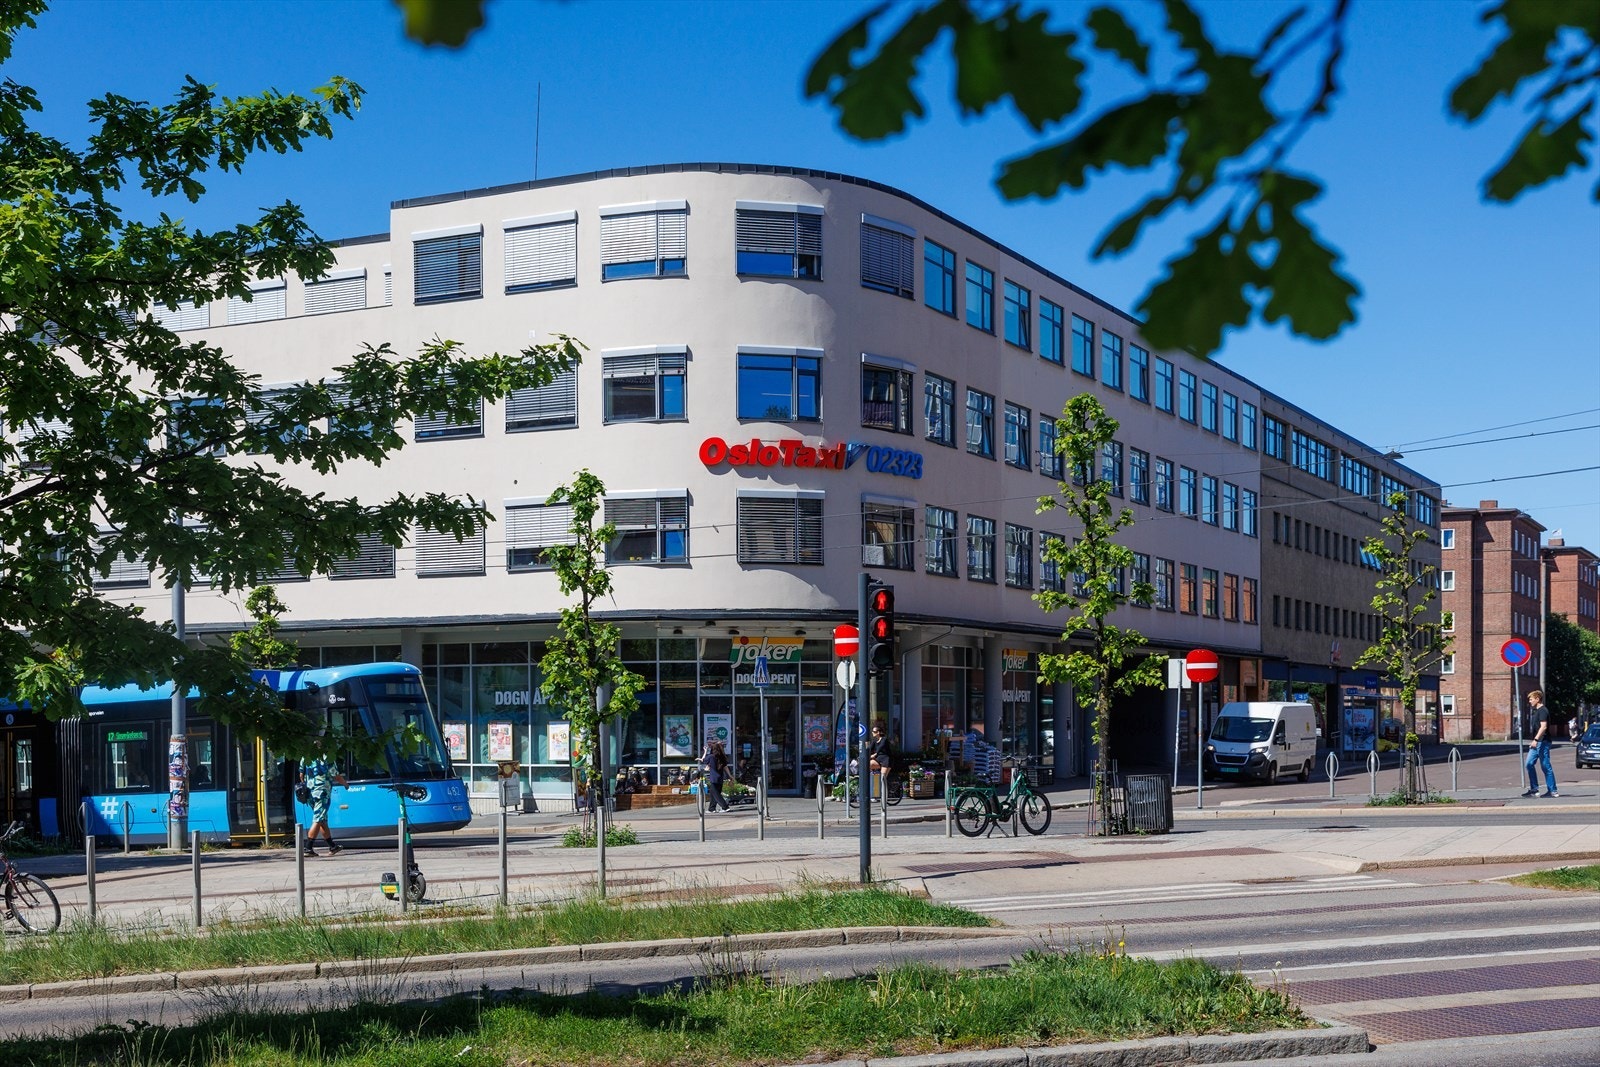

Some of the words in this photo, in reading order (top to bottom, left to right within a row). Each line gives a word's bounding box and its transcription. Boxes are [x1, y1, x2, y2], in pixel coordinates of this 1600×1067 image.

[699, 437, 844, 469] OsloTaxi
[867, 447, 923, 479] 02323
[731, 636, 798, 669] joker
[1003, 649, 1028, 676] joker
[495, 691, 529, 705] DØGN
[447, 786, 461, 796] 482
